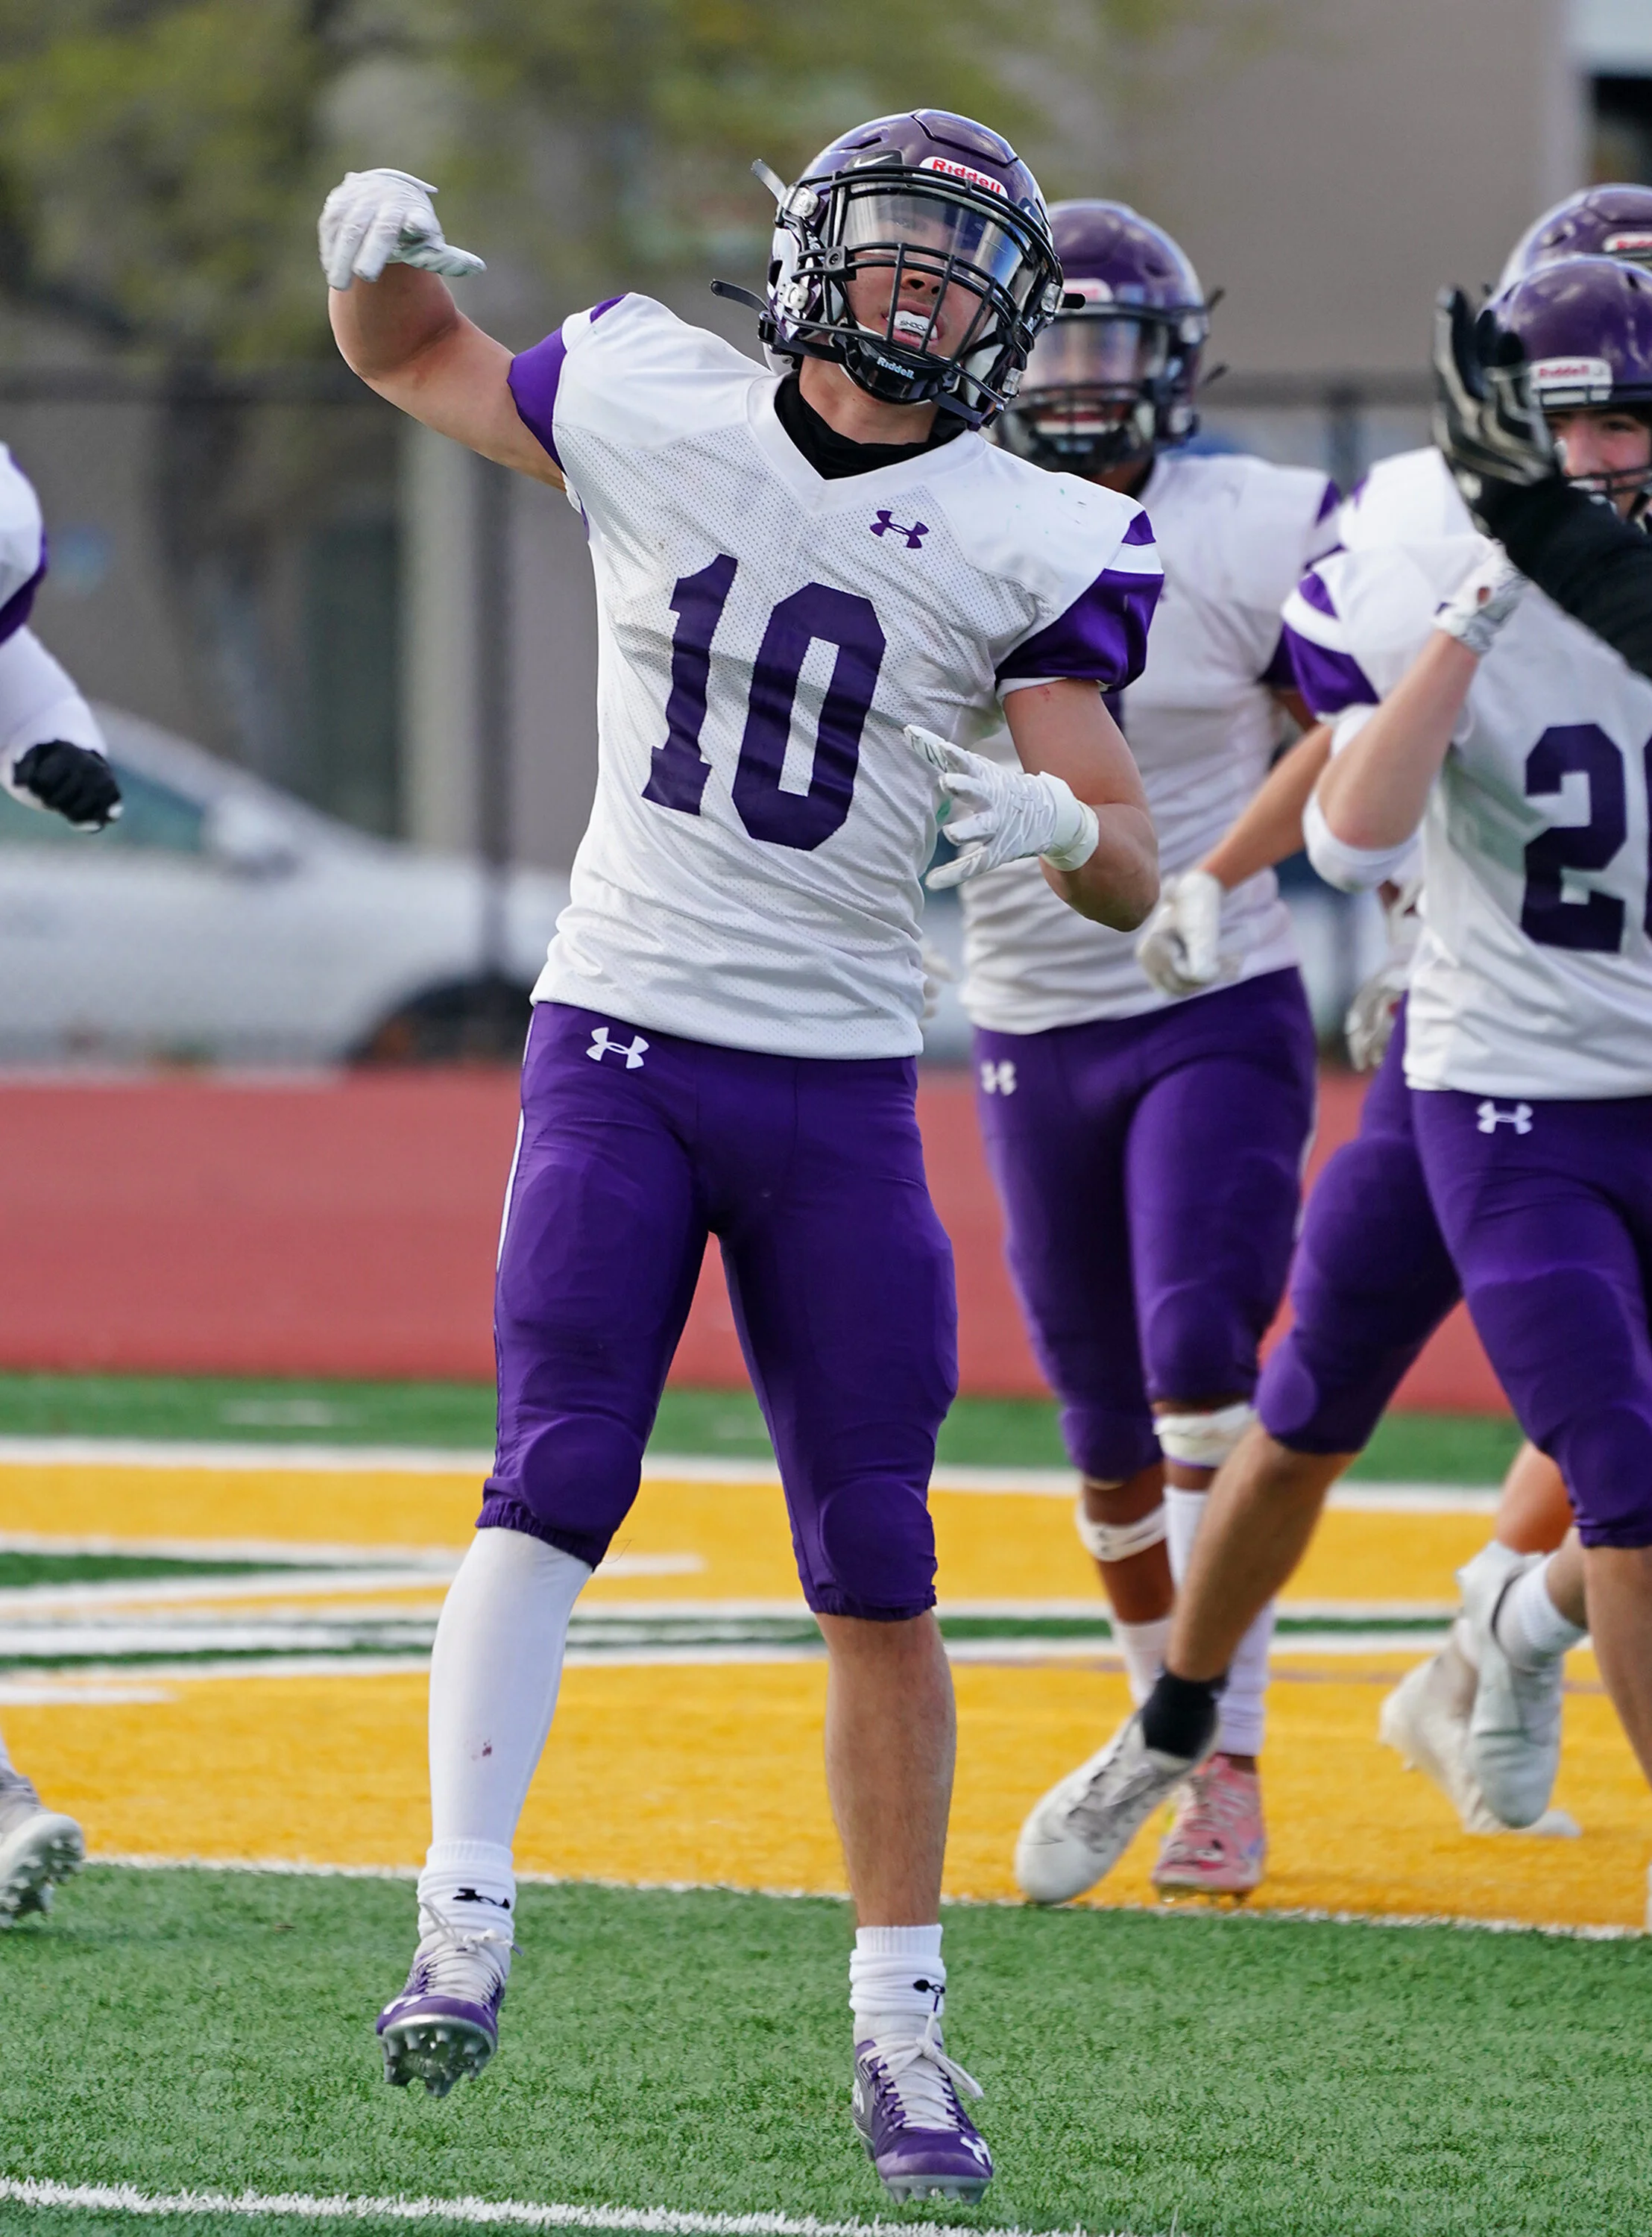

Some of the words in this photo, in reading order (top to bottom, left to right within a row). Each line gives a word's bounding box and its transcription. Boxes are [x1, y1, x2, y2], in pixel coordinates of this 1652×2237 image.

[932, 159, 1001, 194] Riddell
[877, 356, 915, 380] Riddell
[642, 553, 886, 852] 10
[1520, 723, 1652, 953] 2
